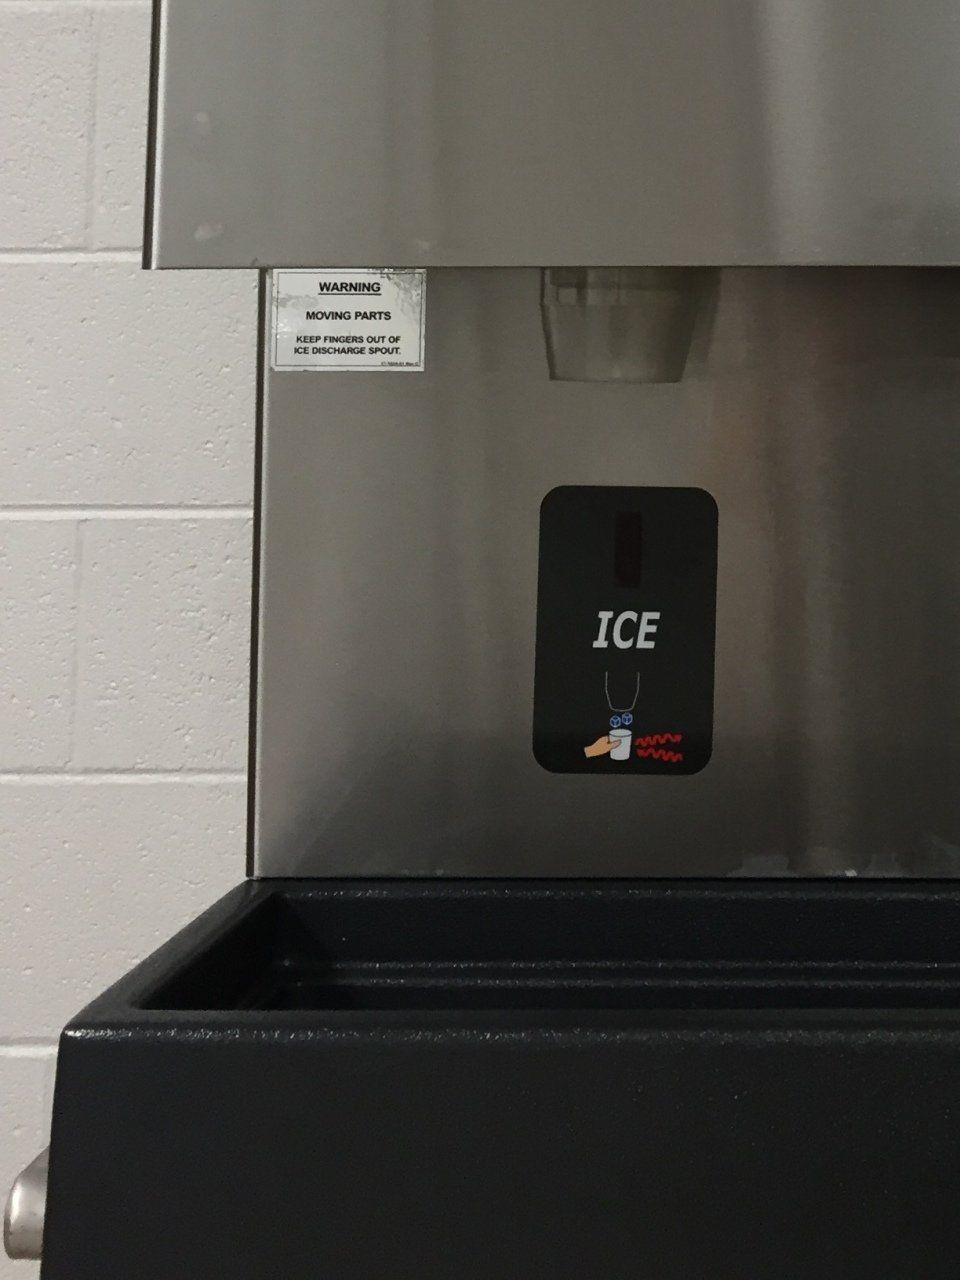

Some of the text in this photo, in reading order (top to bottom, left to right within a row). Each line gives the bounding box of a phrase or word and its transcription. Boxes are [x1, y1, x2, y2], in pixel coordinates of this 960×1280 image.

[319, 282, 381, 293] WARNING
[306, 311, 392, 320] MOVING PARTS
[296, 336, 401, 344] KEEP FINGERS OUT OF
[294, 347, 401, 355] ICE DISCHARGE SPOUT.
[592, 610, 661, 649] ICE
